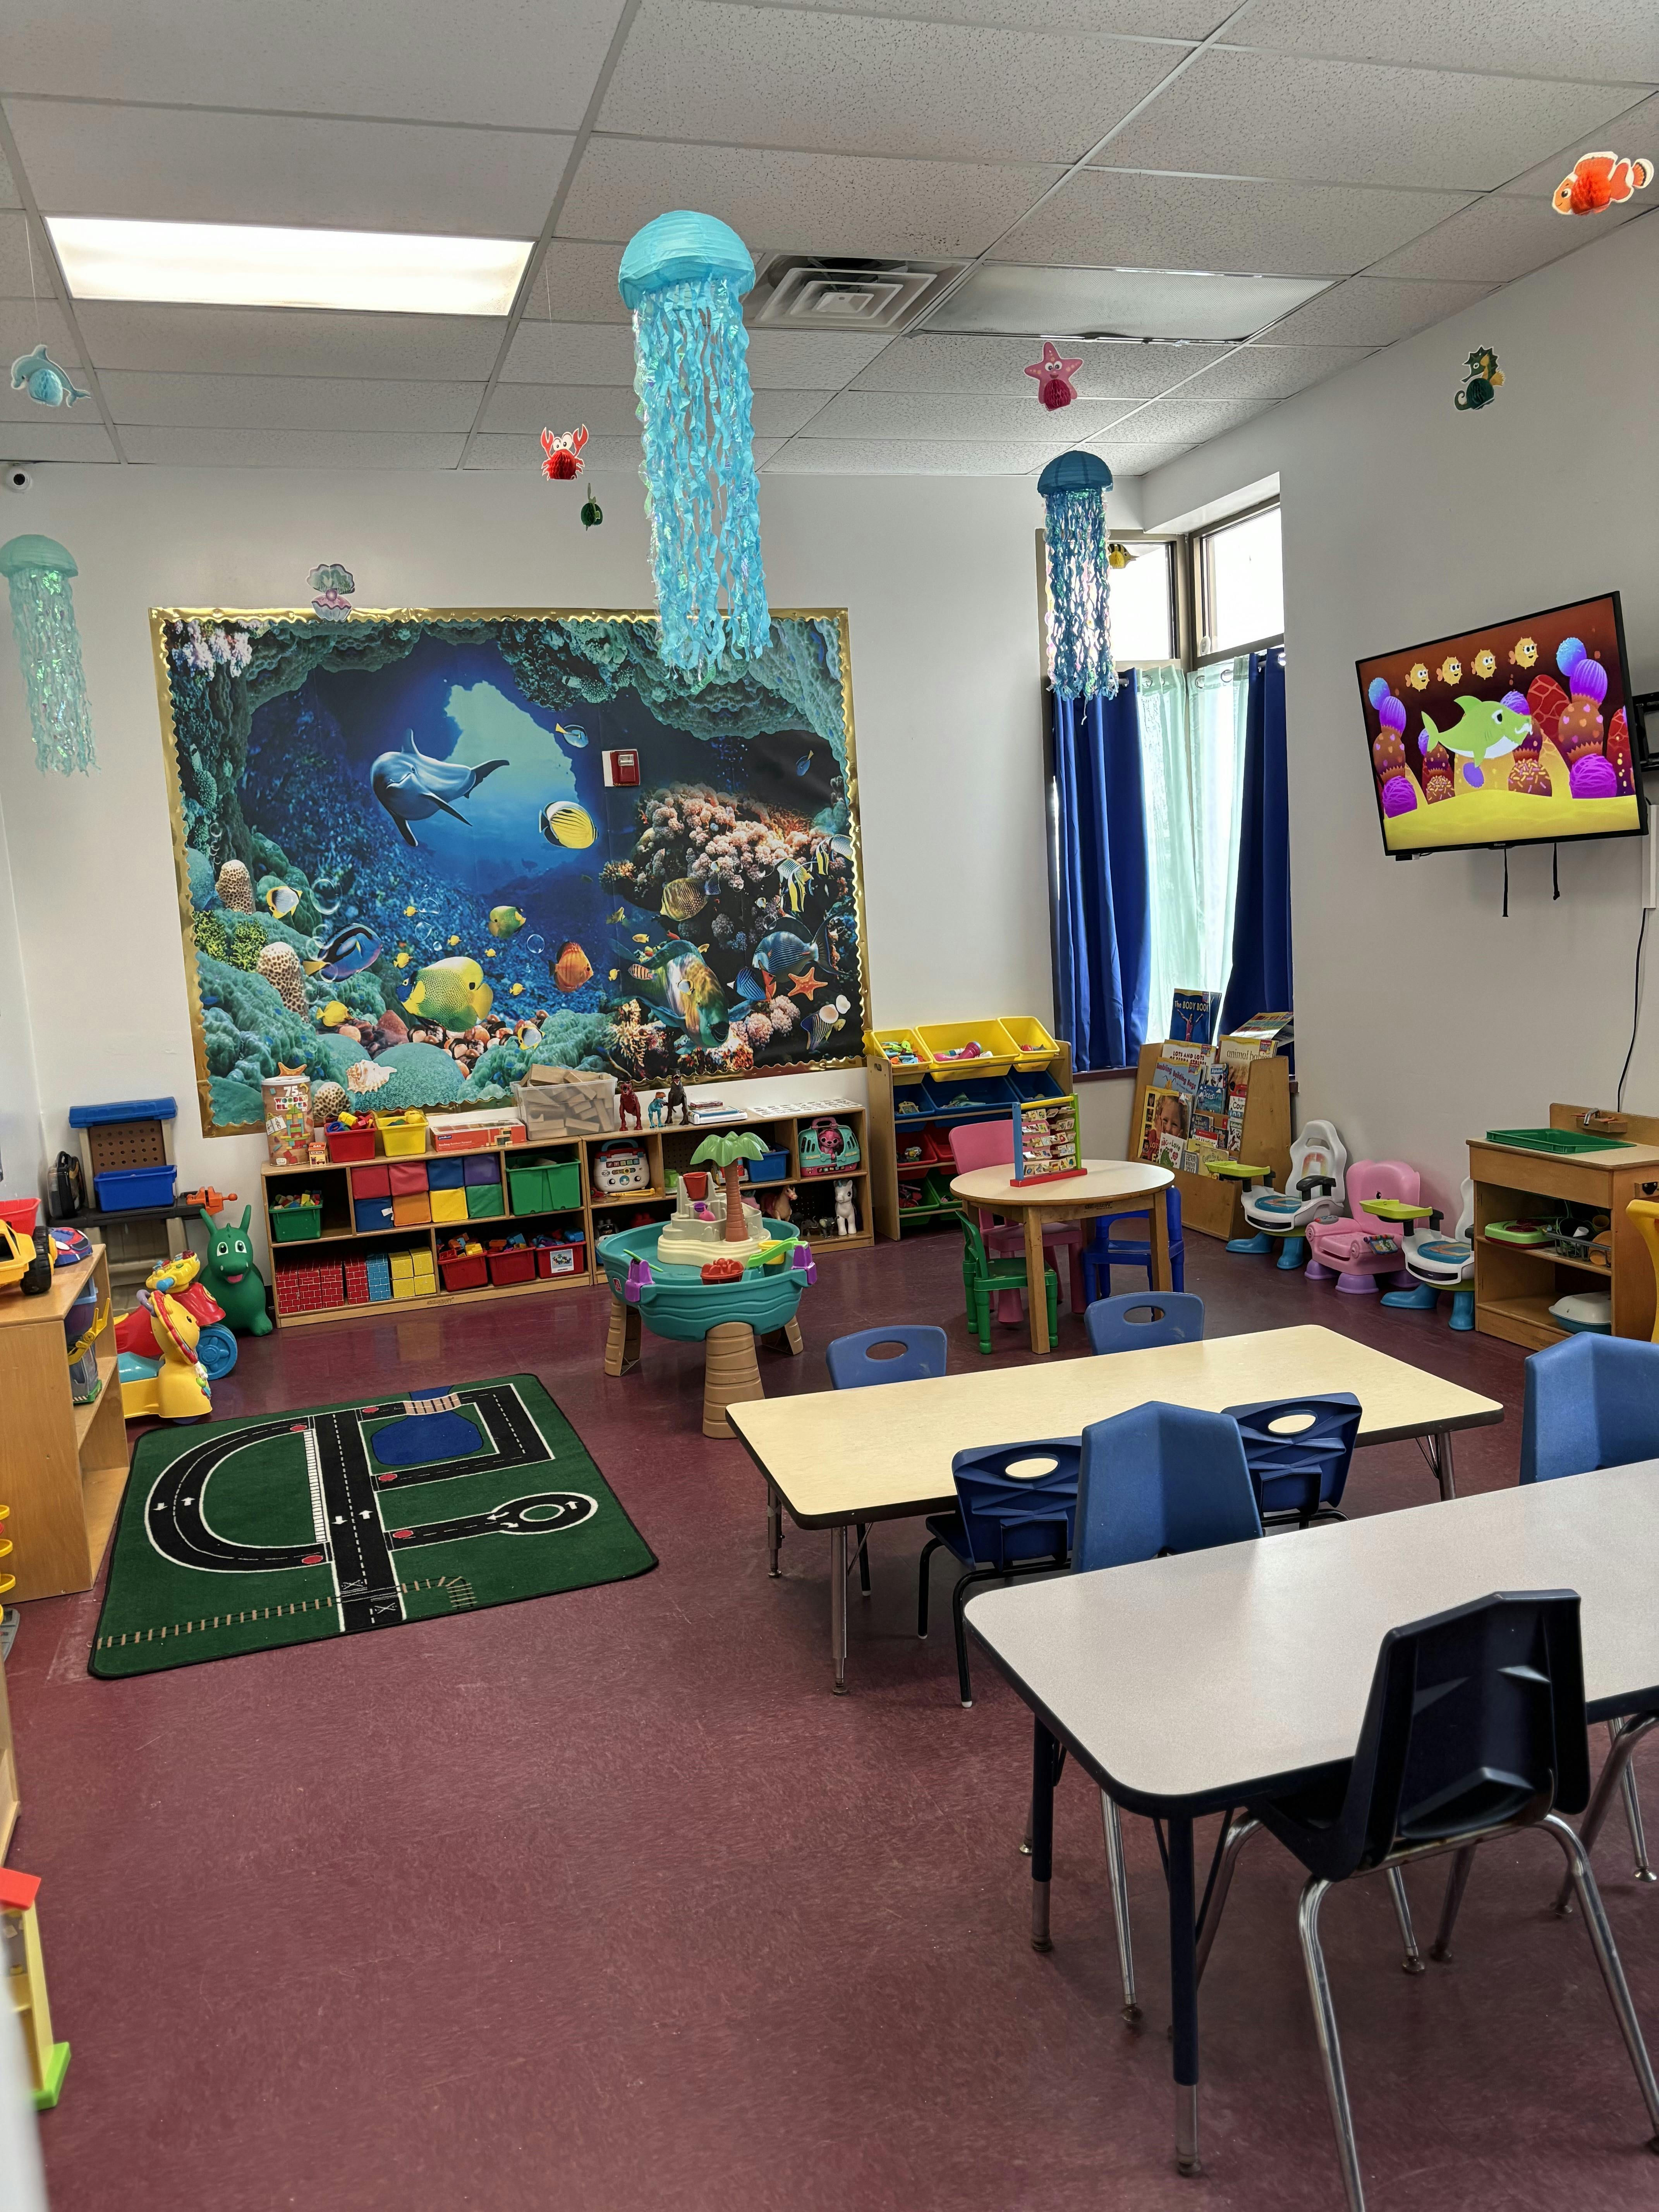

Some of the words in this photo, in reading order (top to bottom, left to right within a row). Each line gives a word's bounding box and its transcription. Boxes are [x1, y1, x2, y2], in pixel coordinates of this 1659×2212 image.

[1183, 1001, 1196, 1010] BODY
[1197, 1003, 1209, 1012] BOOK
[1227, 1049, 1249, 1060] animal
[283, 1085, 299, 1097] 75
[1203, 1089, 1215, 1099] Ocean
[274, 1094, 308, 1104] WOODEN
[1171, 1140, 1181, 1151] Love
